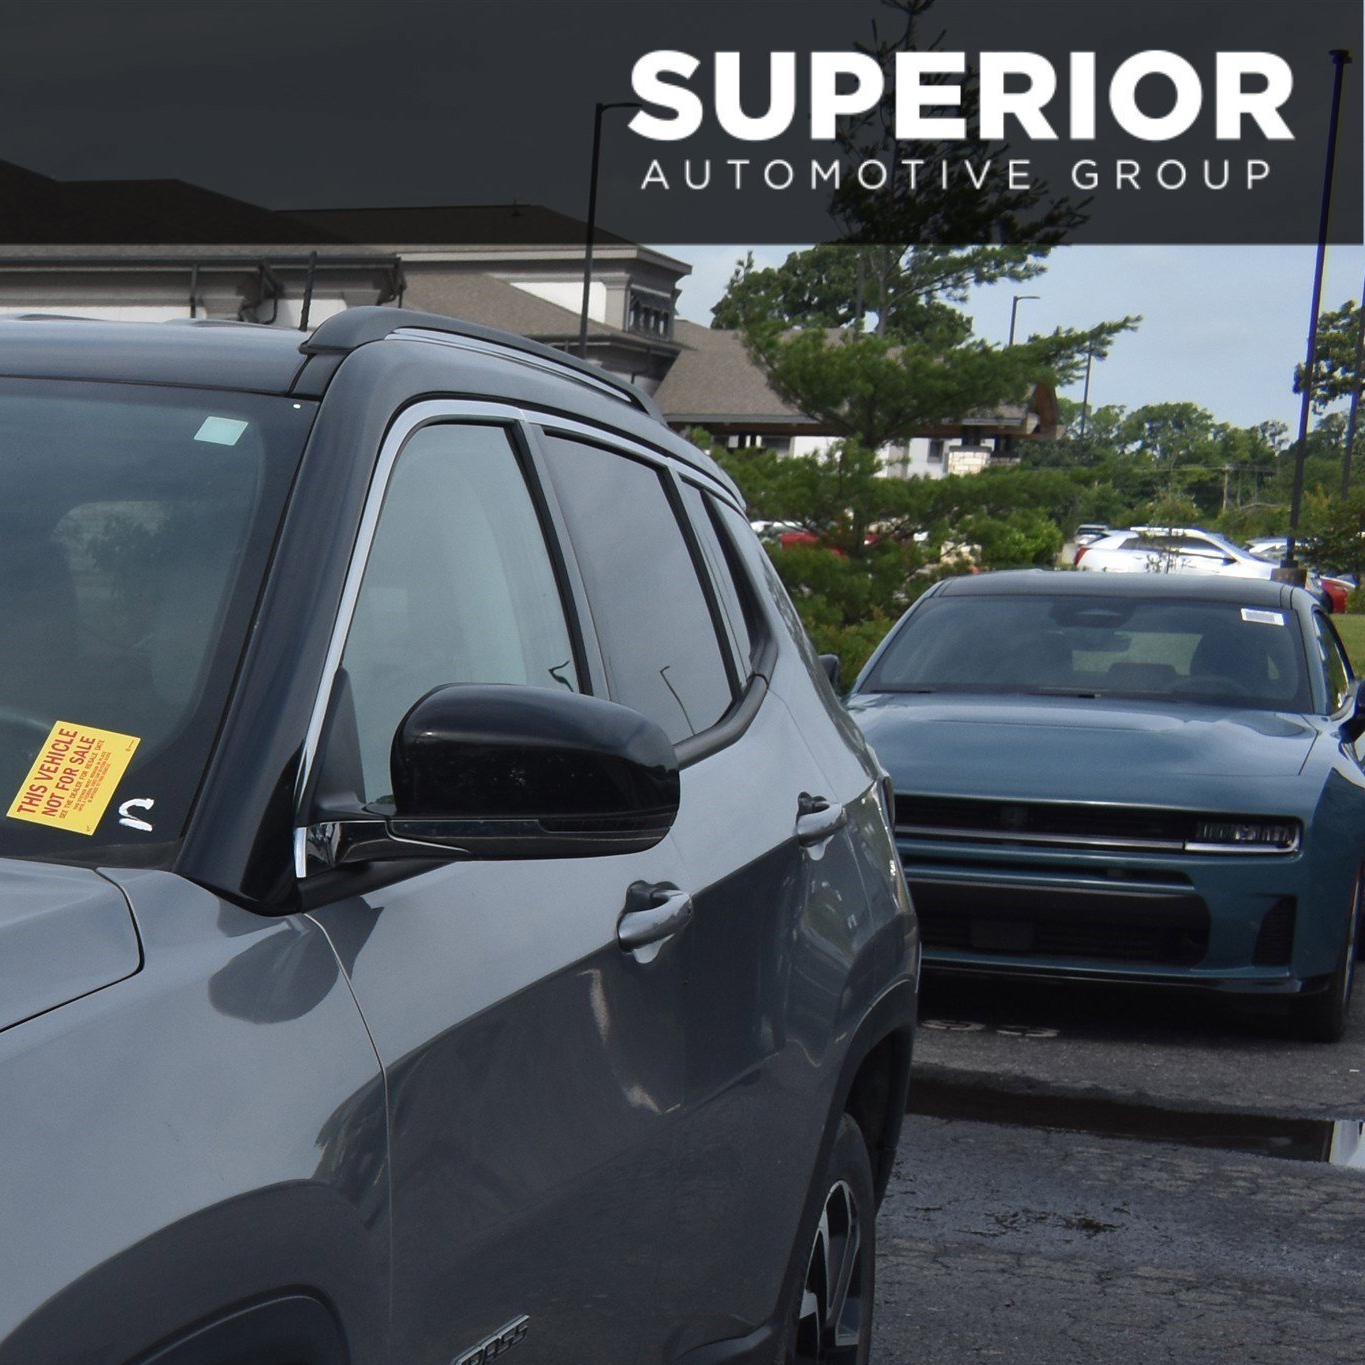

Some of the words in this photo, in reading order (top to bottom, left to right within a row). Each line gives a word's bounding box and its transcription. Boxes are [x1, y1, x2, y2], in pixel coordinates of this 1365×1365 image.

[32, 727, 78, 783] VEHICLE
[40, 792, 66, 817] NOT
[54, 766, 80, 791] FOR
[67, 734, 96, 765] SALE
[15, 782, 50, 815] THIS
